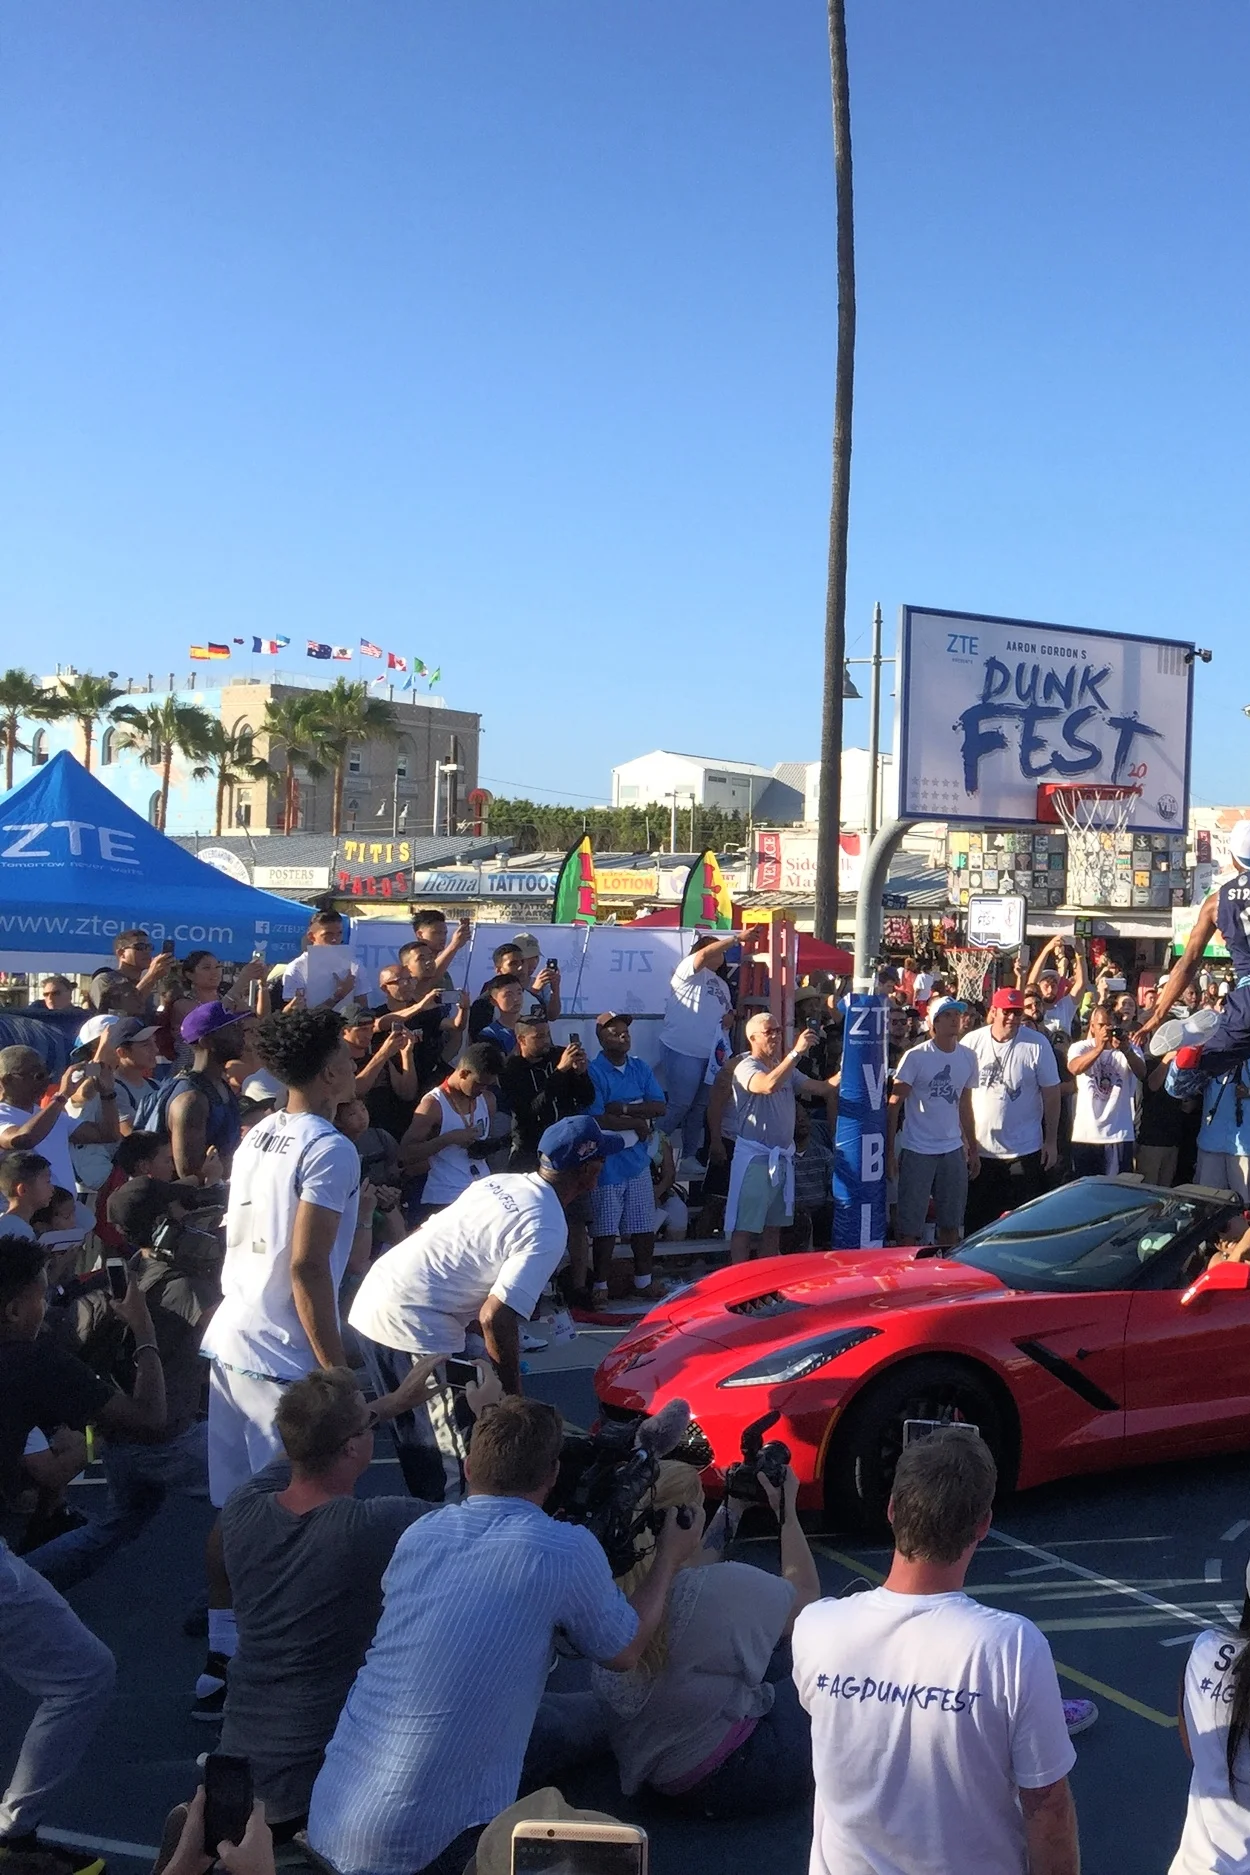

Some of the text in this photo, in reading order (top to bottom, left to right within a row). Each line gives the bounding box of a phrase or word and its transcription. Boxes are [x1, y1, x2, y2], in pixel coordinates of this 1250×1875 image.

[947, 634, 979, 655] ZTE
[1006, 641, 1037, 653] AARON
[977, 655, 1113, 713] DUNK
[952, 702, 1165, 798] FEST
[1128, 762, 1148, 778] 20
[1, 820, 141, 865] ZTE
[344, 840, 410, 864] TITIS
[762, 836, 776, 886] VENICE
[269, 869, 315, 880] POSTERS
[337, 869, 408, 899] TACOS
[420, 872, 478, 892] Henna
[603, 877, 655, 891] LOTION
[816, 1673, 983, 1715] #AGDUNKFEST
